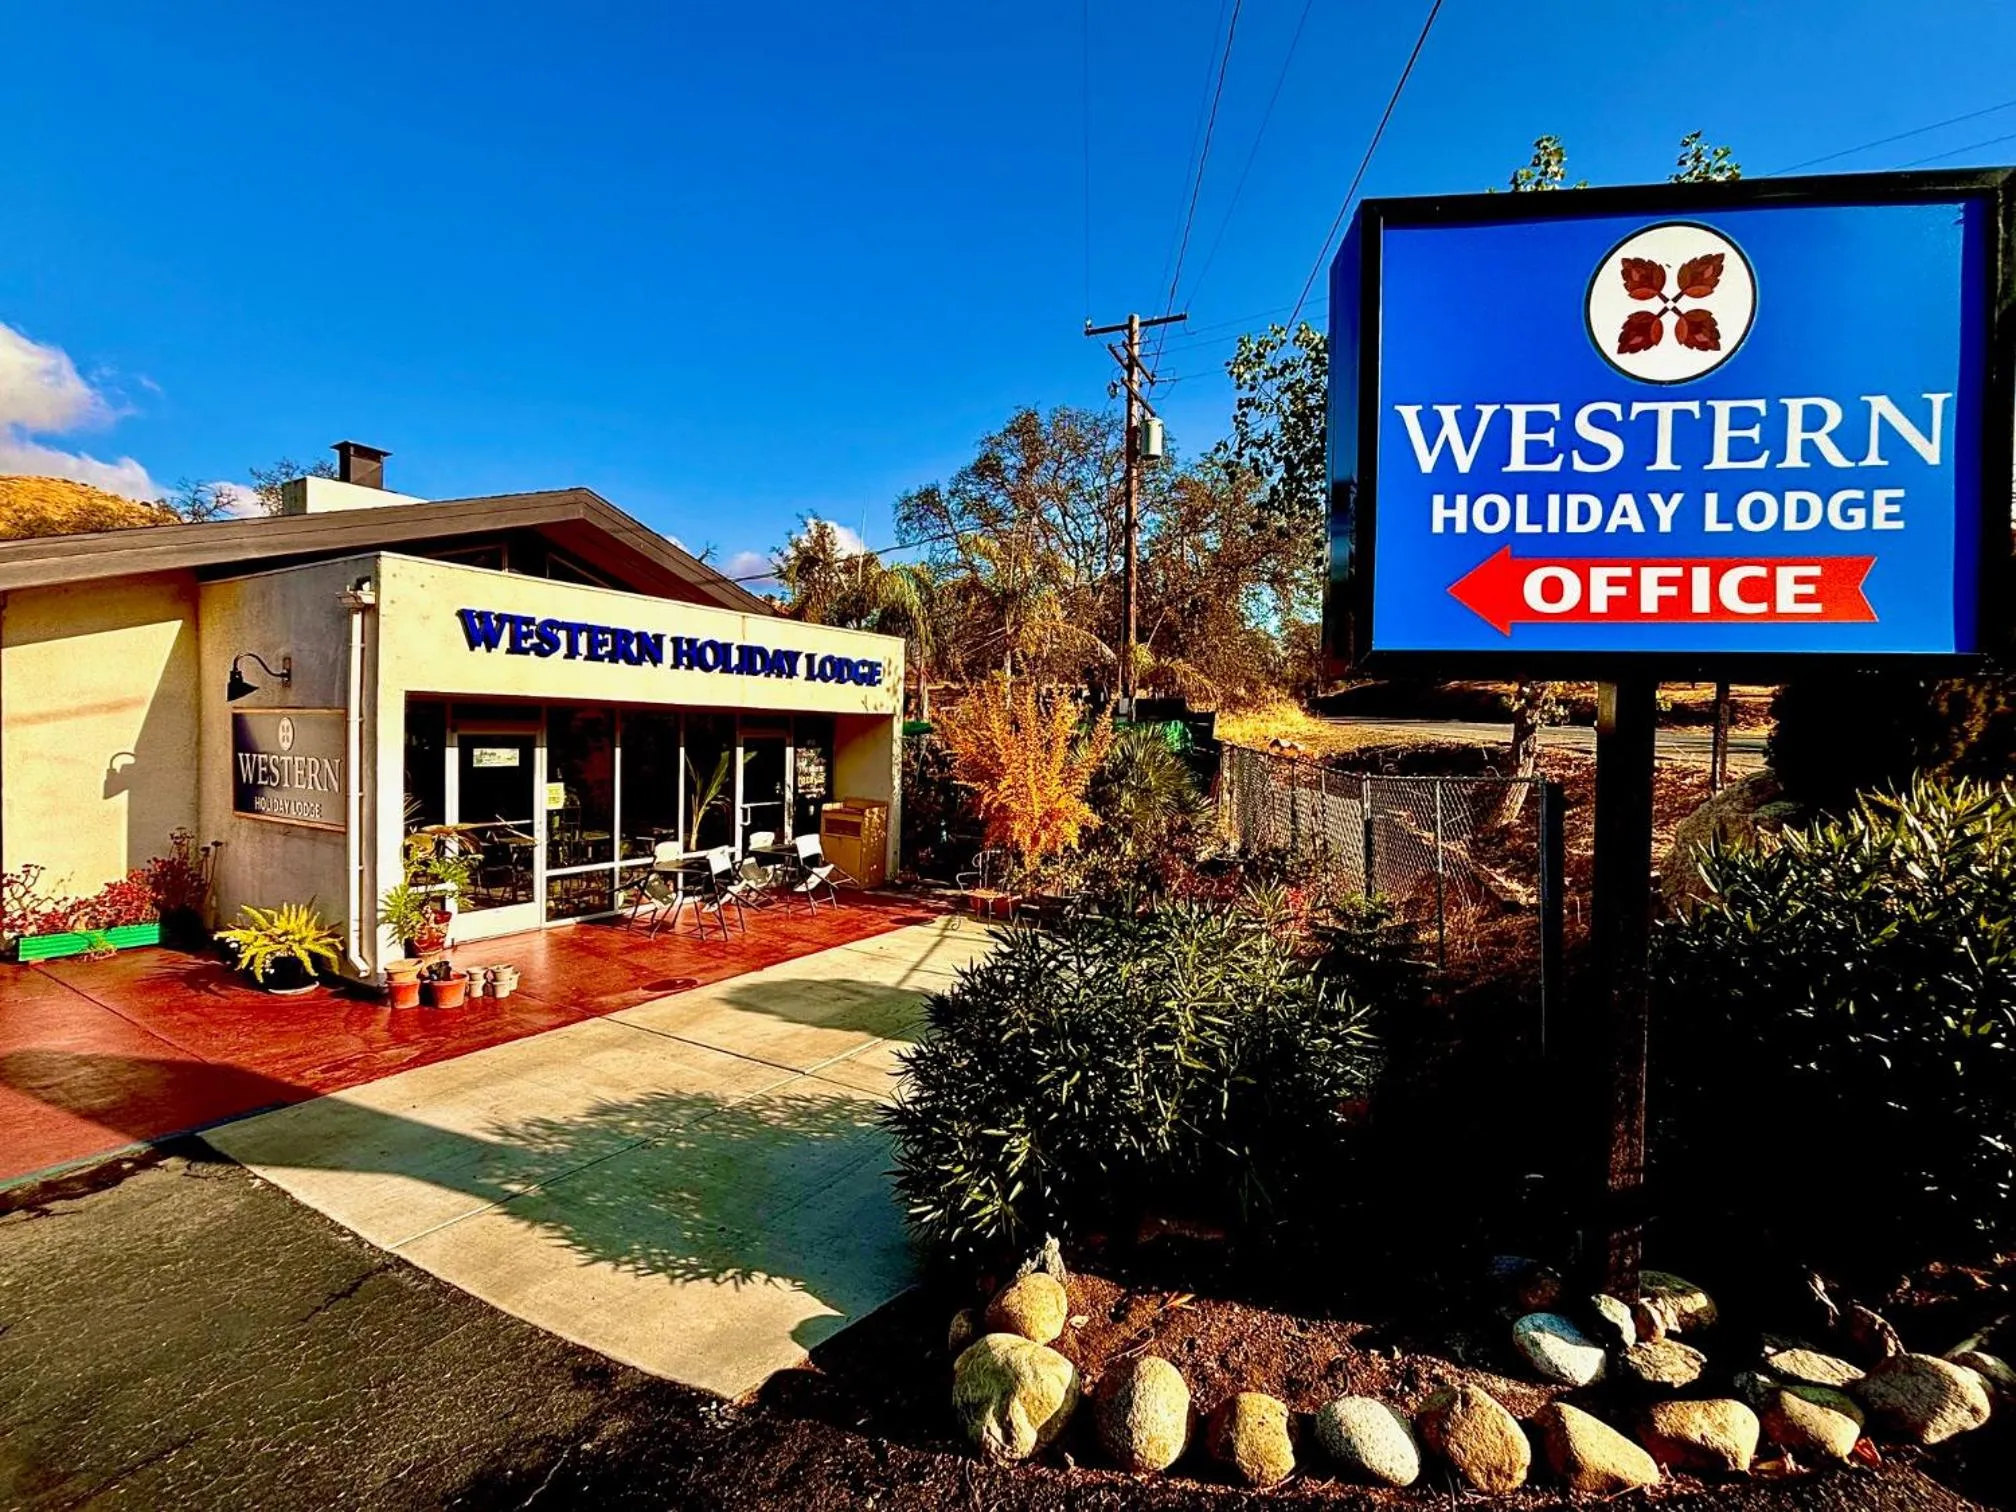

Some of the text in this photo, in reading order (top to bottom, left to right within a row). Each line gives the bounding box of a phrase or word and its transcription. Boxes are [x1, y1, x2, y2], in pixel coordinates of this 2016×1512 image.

[1395, 392, 1953, 474] WESTERN
[1431, 488, 1907, 535] HOLIDAY LODGE
[1522, 564, 1824, 615] OFFICE
[457, 608, 883, 686] WESTERN HOLIDAY LODGE
[238, 752, 342, 793] WESTERN
[254, 796, 322, 818] HOLIDAY LODGE
